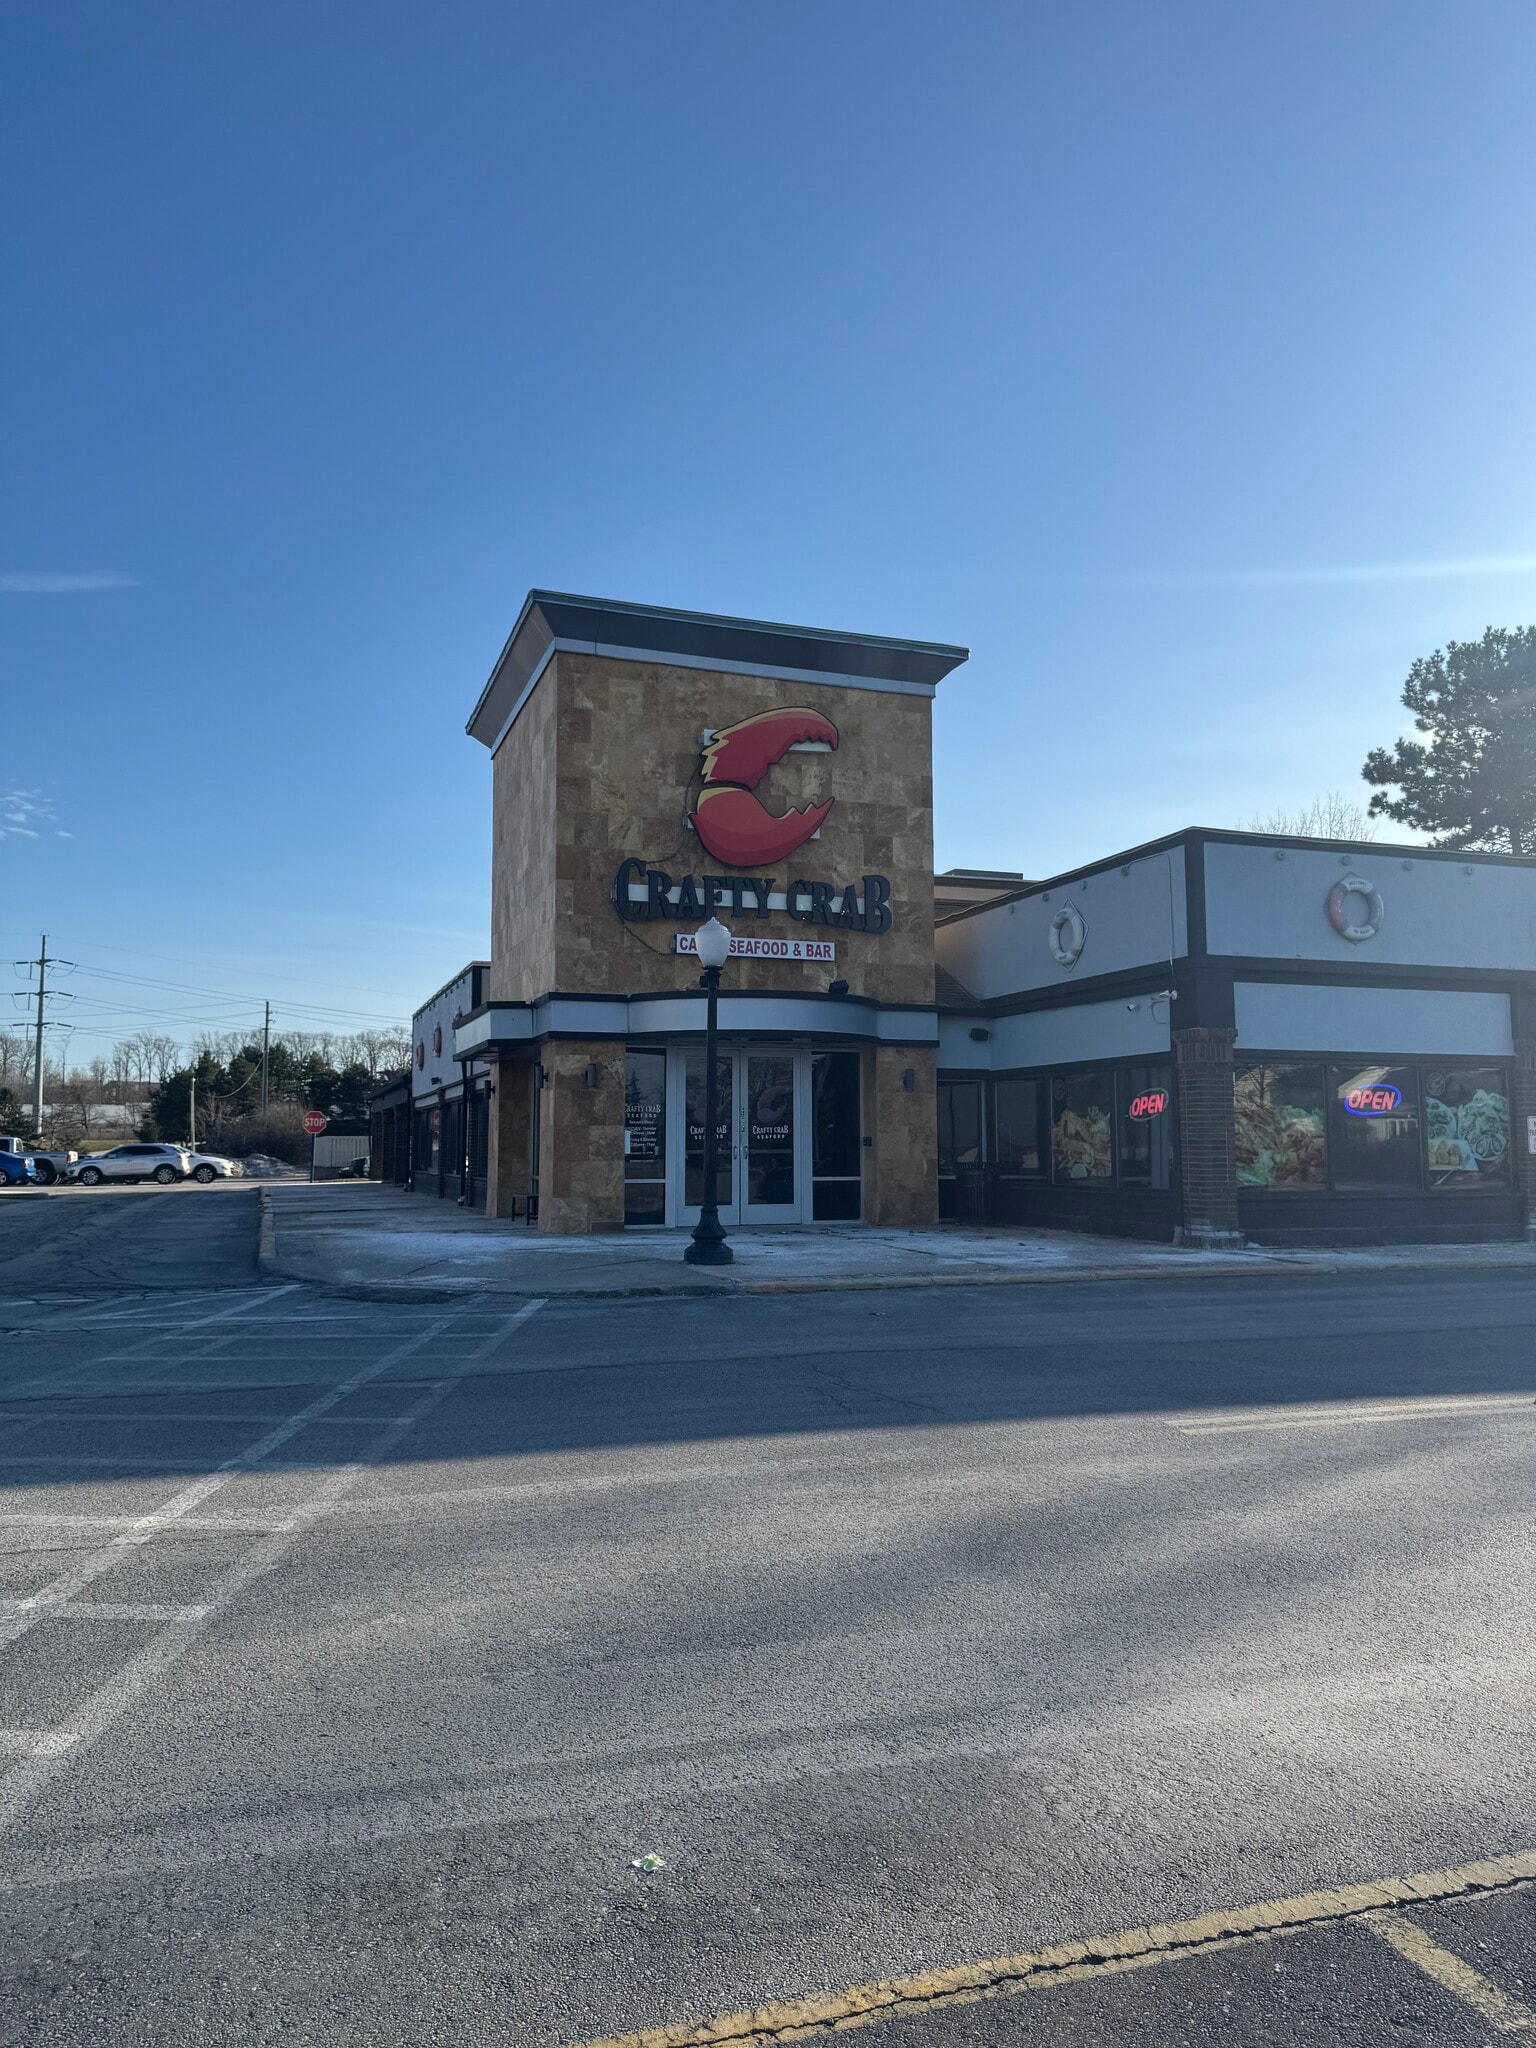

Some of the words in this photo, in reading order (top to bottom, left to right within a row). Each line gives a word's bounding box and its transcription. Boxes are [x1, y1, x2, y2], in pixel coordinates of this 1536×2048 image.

[616, 857, 776, 922] CRAFTY
[786, 874, 893, 934] CRAB
[729, 939, 788, 956] SEAFOOD
[793, 943, 801, 956] &
[806, 943, 831, 958] BAR
[1131, 1093, 1164, 1117] OPEN
[1348, 1089, 1396, 1110] OPEN
[304, 1117, 325, 1127] STOP
[752, 1125, 773, 1134] CRAFTY
[773, 1124, 789, 1134] CRAB
